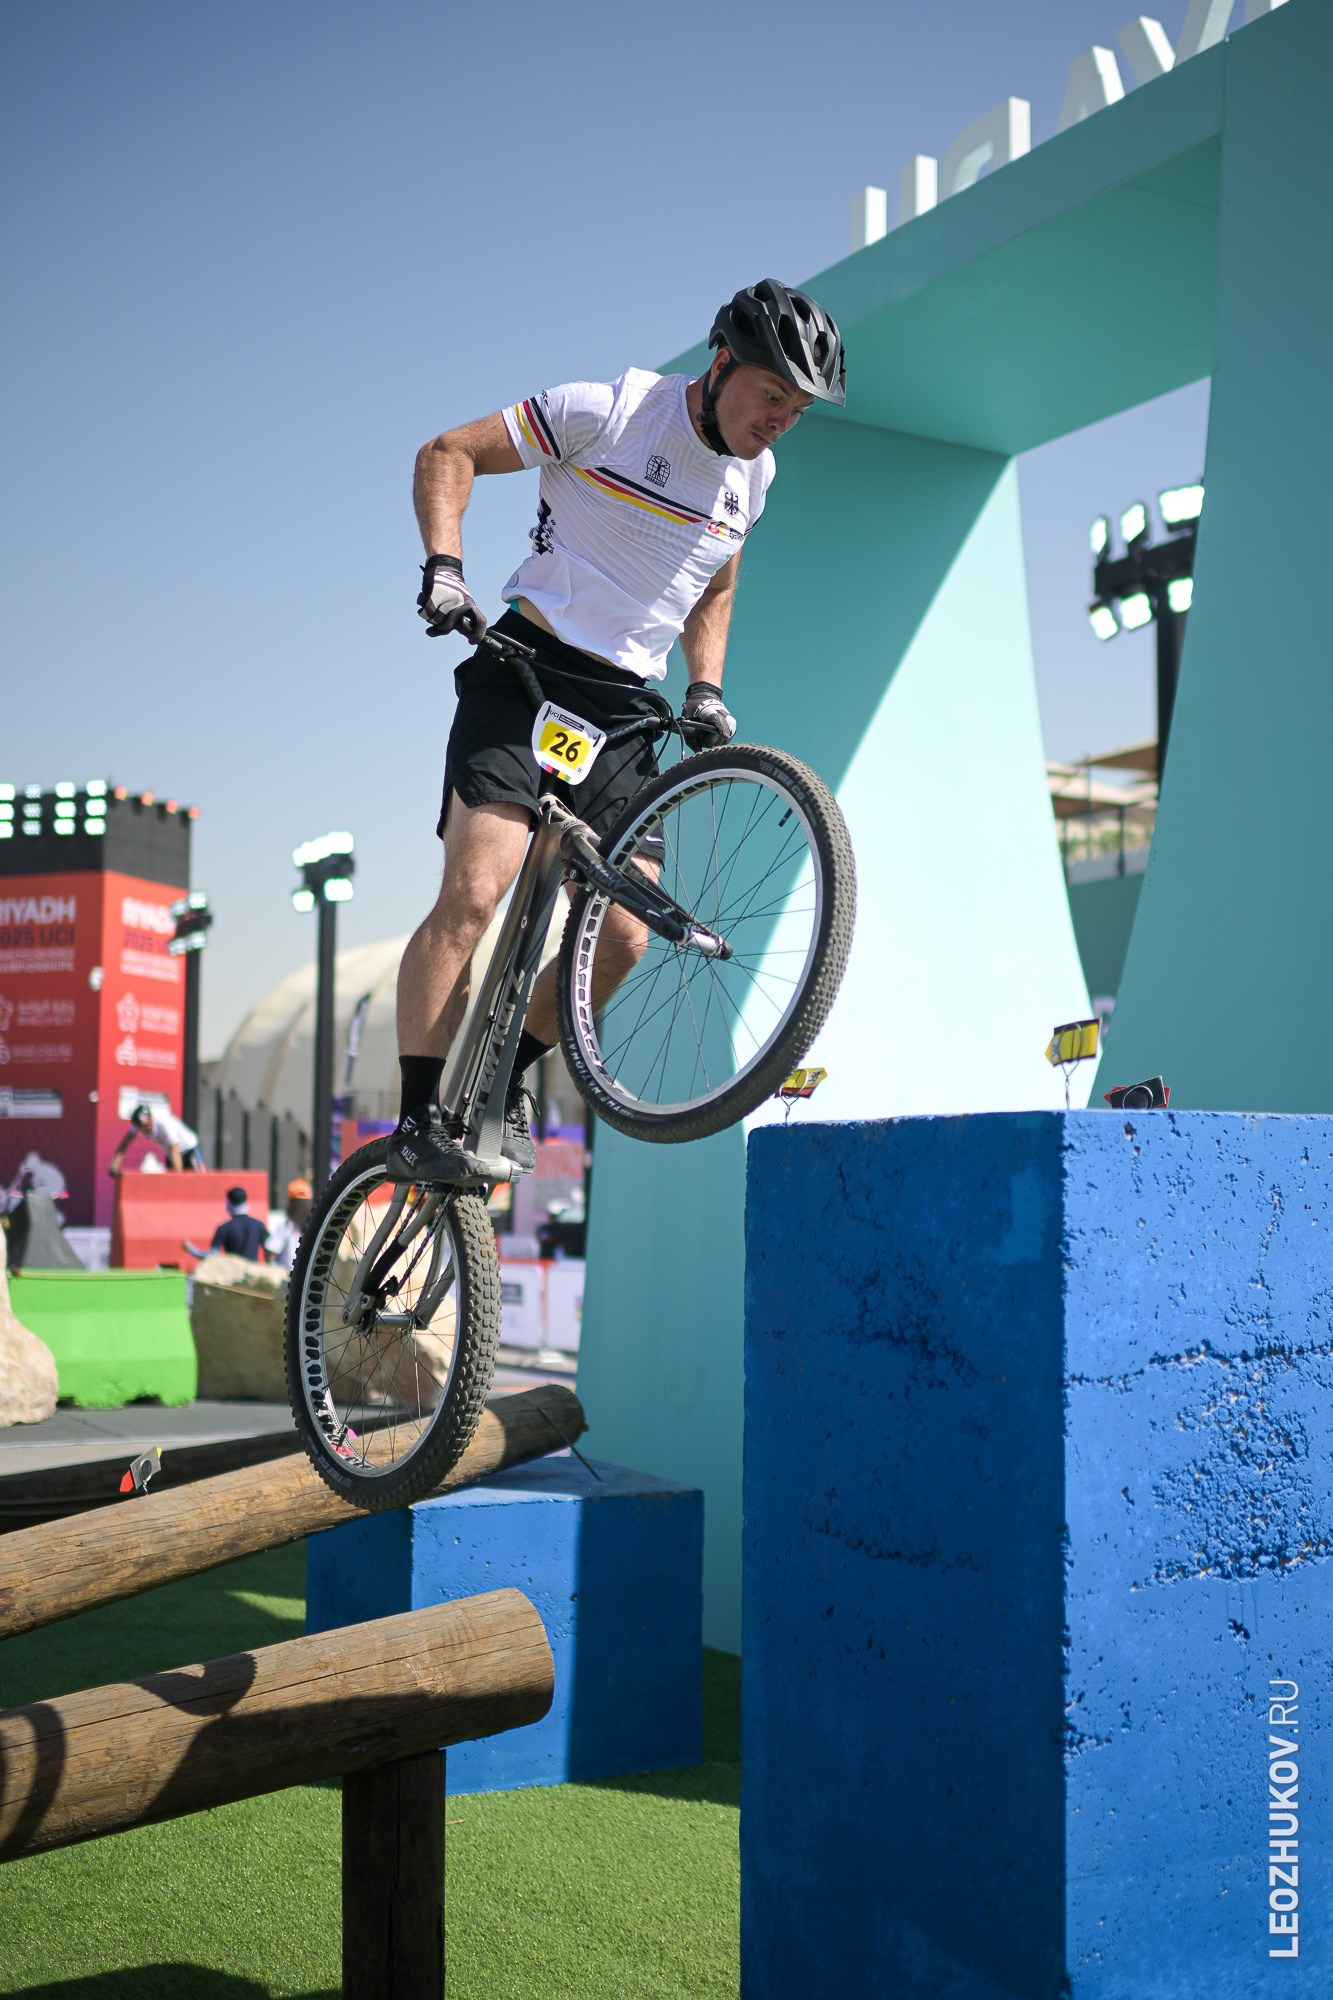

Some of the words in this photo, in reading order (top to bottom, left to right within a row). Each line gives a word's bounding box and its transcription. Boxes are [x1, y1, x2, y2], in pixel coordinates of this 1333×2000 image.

[549, 731, 582, 763] 26
[0, 896, 76, 926] IYADH
[0, 928, 34, 948] 025
[40, 926, 75, 948] UCI
[565, 1035, 602, 1095] NATIONAL
